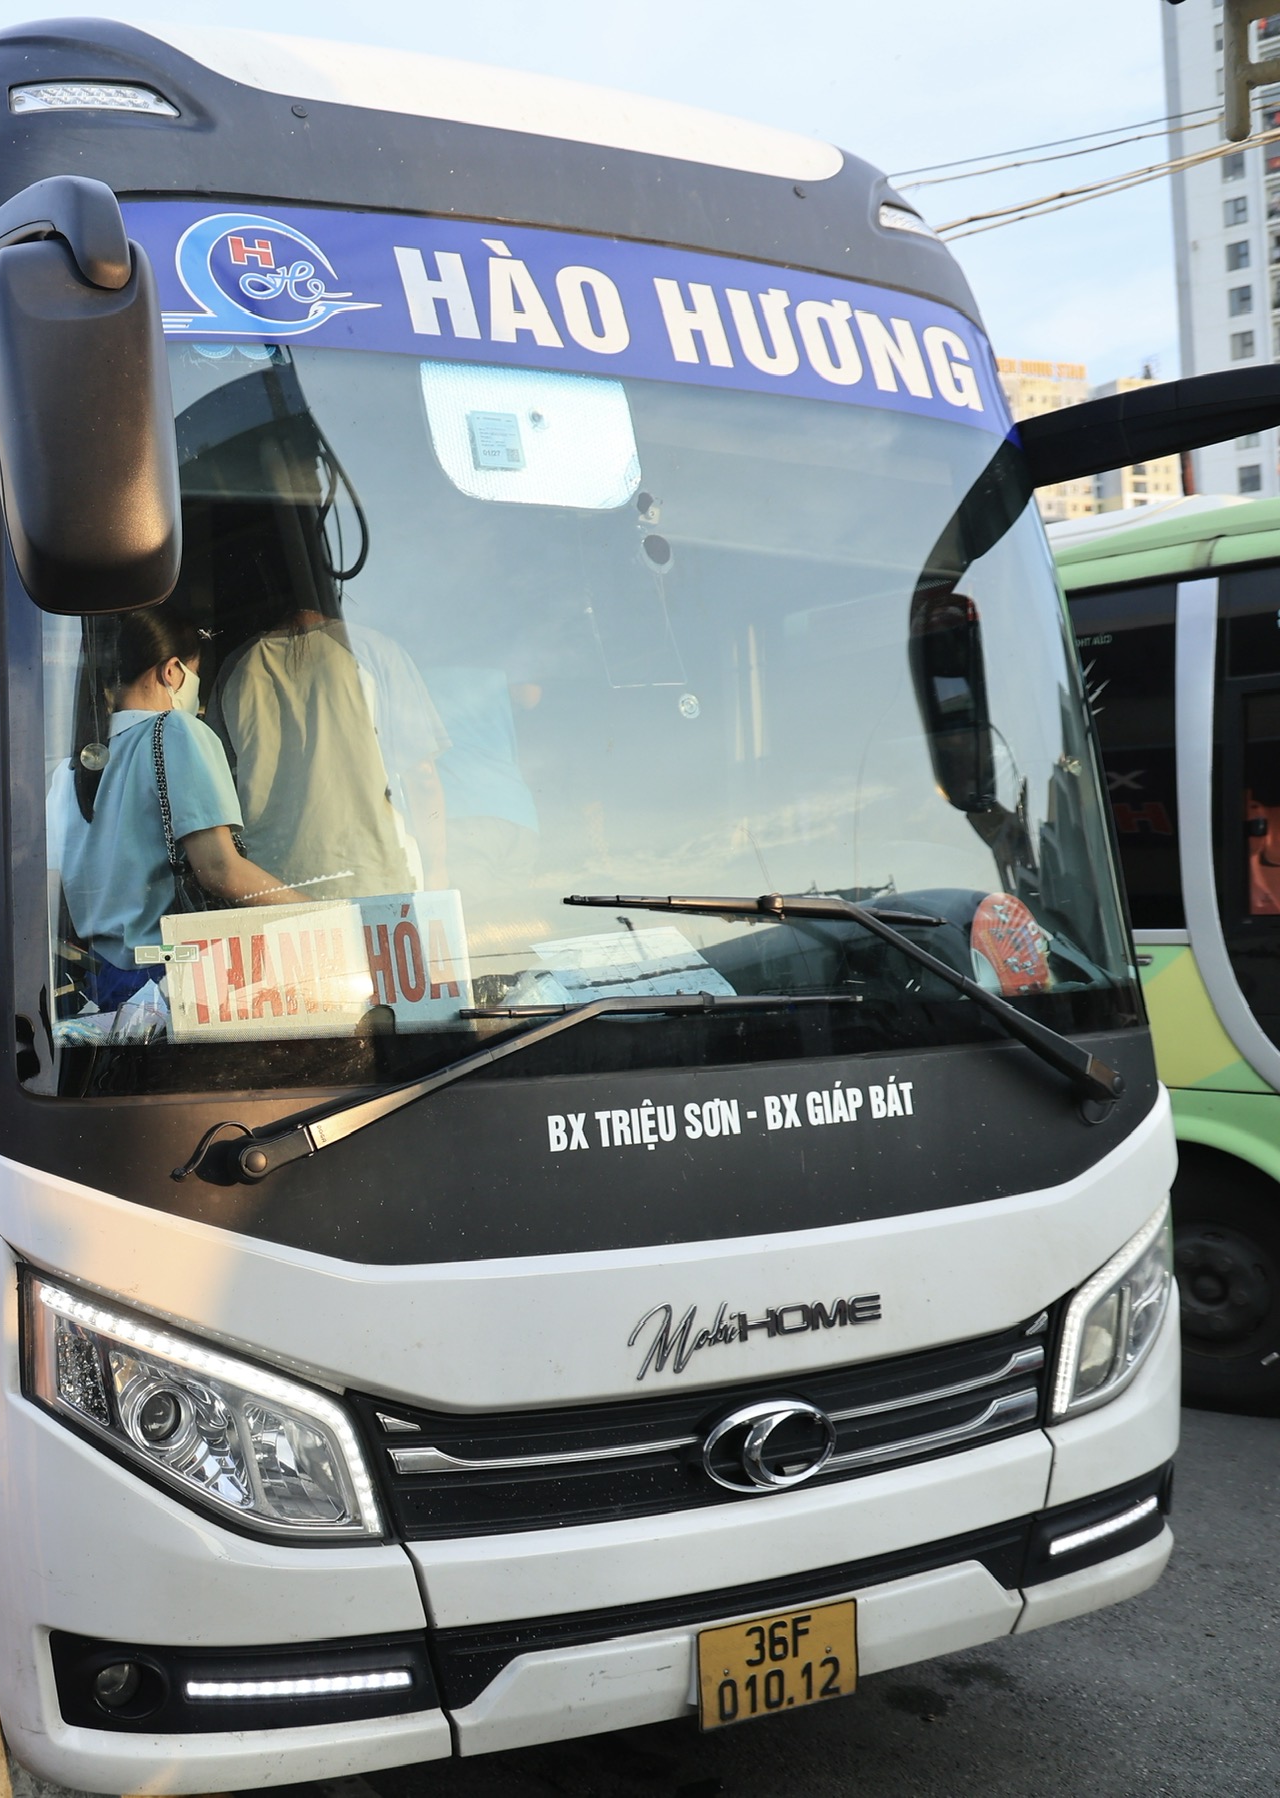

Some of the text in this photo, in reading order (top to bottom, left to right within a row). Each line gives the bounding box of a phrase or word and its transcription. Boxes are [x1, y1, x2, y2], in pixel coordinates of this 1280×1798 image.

[393, 238, 984, 412] HÀO HƯƠNG
[181, 925, 348, 1025] THANH
[363, 904, 461, 1006] HÓA
[547, 1113, 589, 1152] BX
[595, 1099, 677, 1151] TRIỆU
[684, 1098, 741, 1140] SƠN
[764, 1093, 802, 1130] BX
[806, 1081, 864, 1126] GIÁP
[869, 1075, 914, 1119] BÁT
[745, 1615, 812, 1667] 36F
[718, 1656, 841, 1722] 010.12
